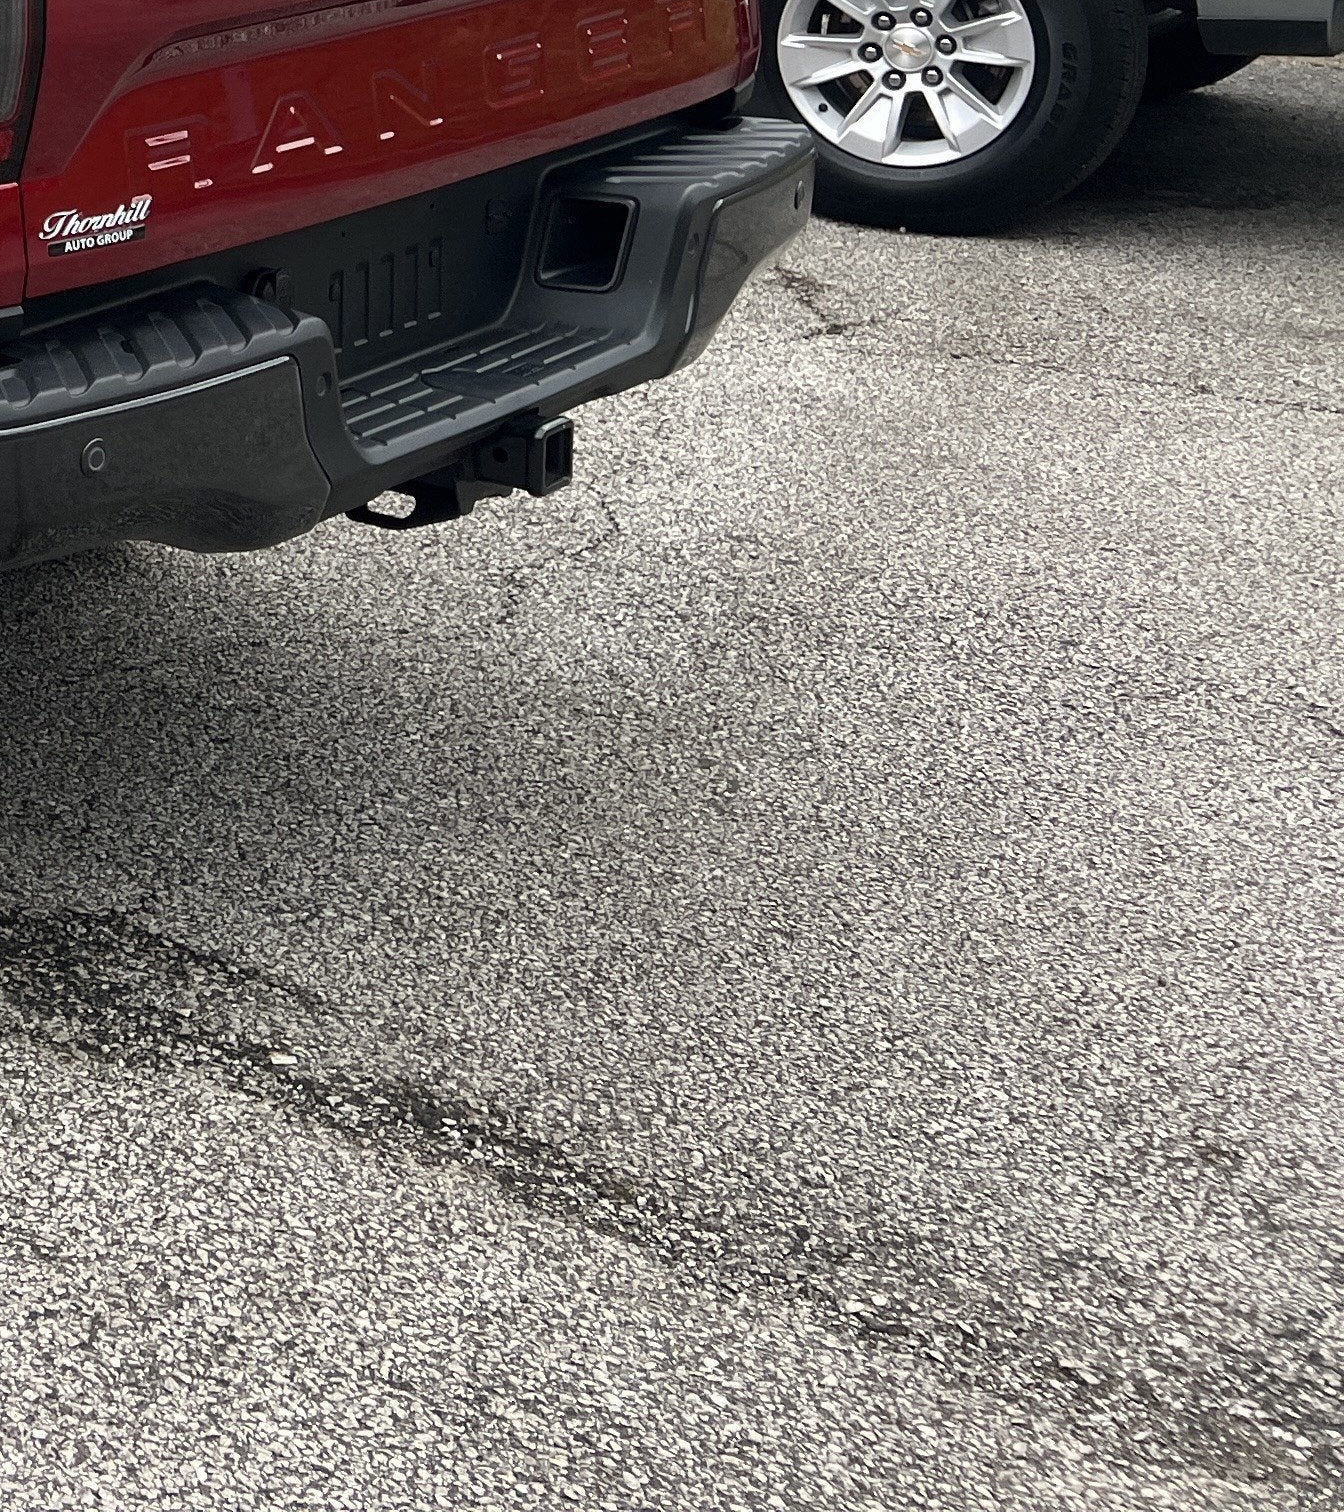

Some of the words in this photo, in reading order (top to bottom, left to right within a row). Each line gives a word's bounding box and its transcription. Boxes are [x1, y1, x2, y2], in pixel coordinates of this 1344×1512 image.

[38, 197, 152, 240] Thornhill
[64, 237, 95, 253] AUTO
[96, 229, 134, 246] GROUP
